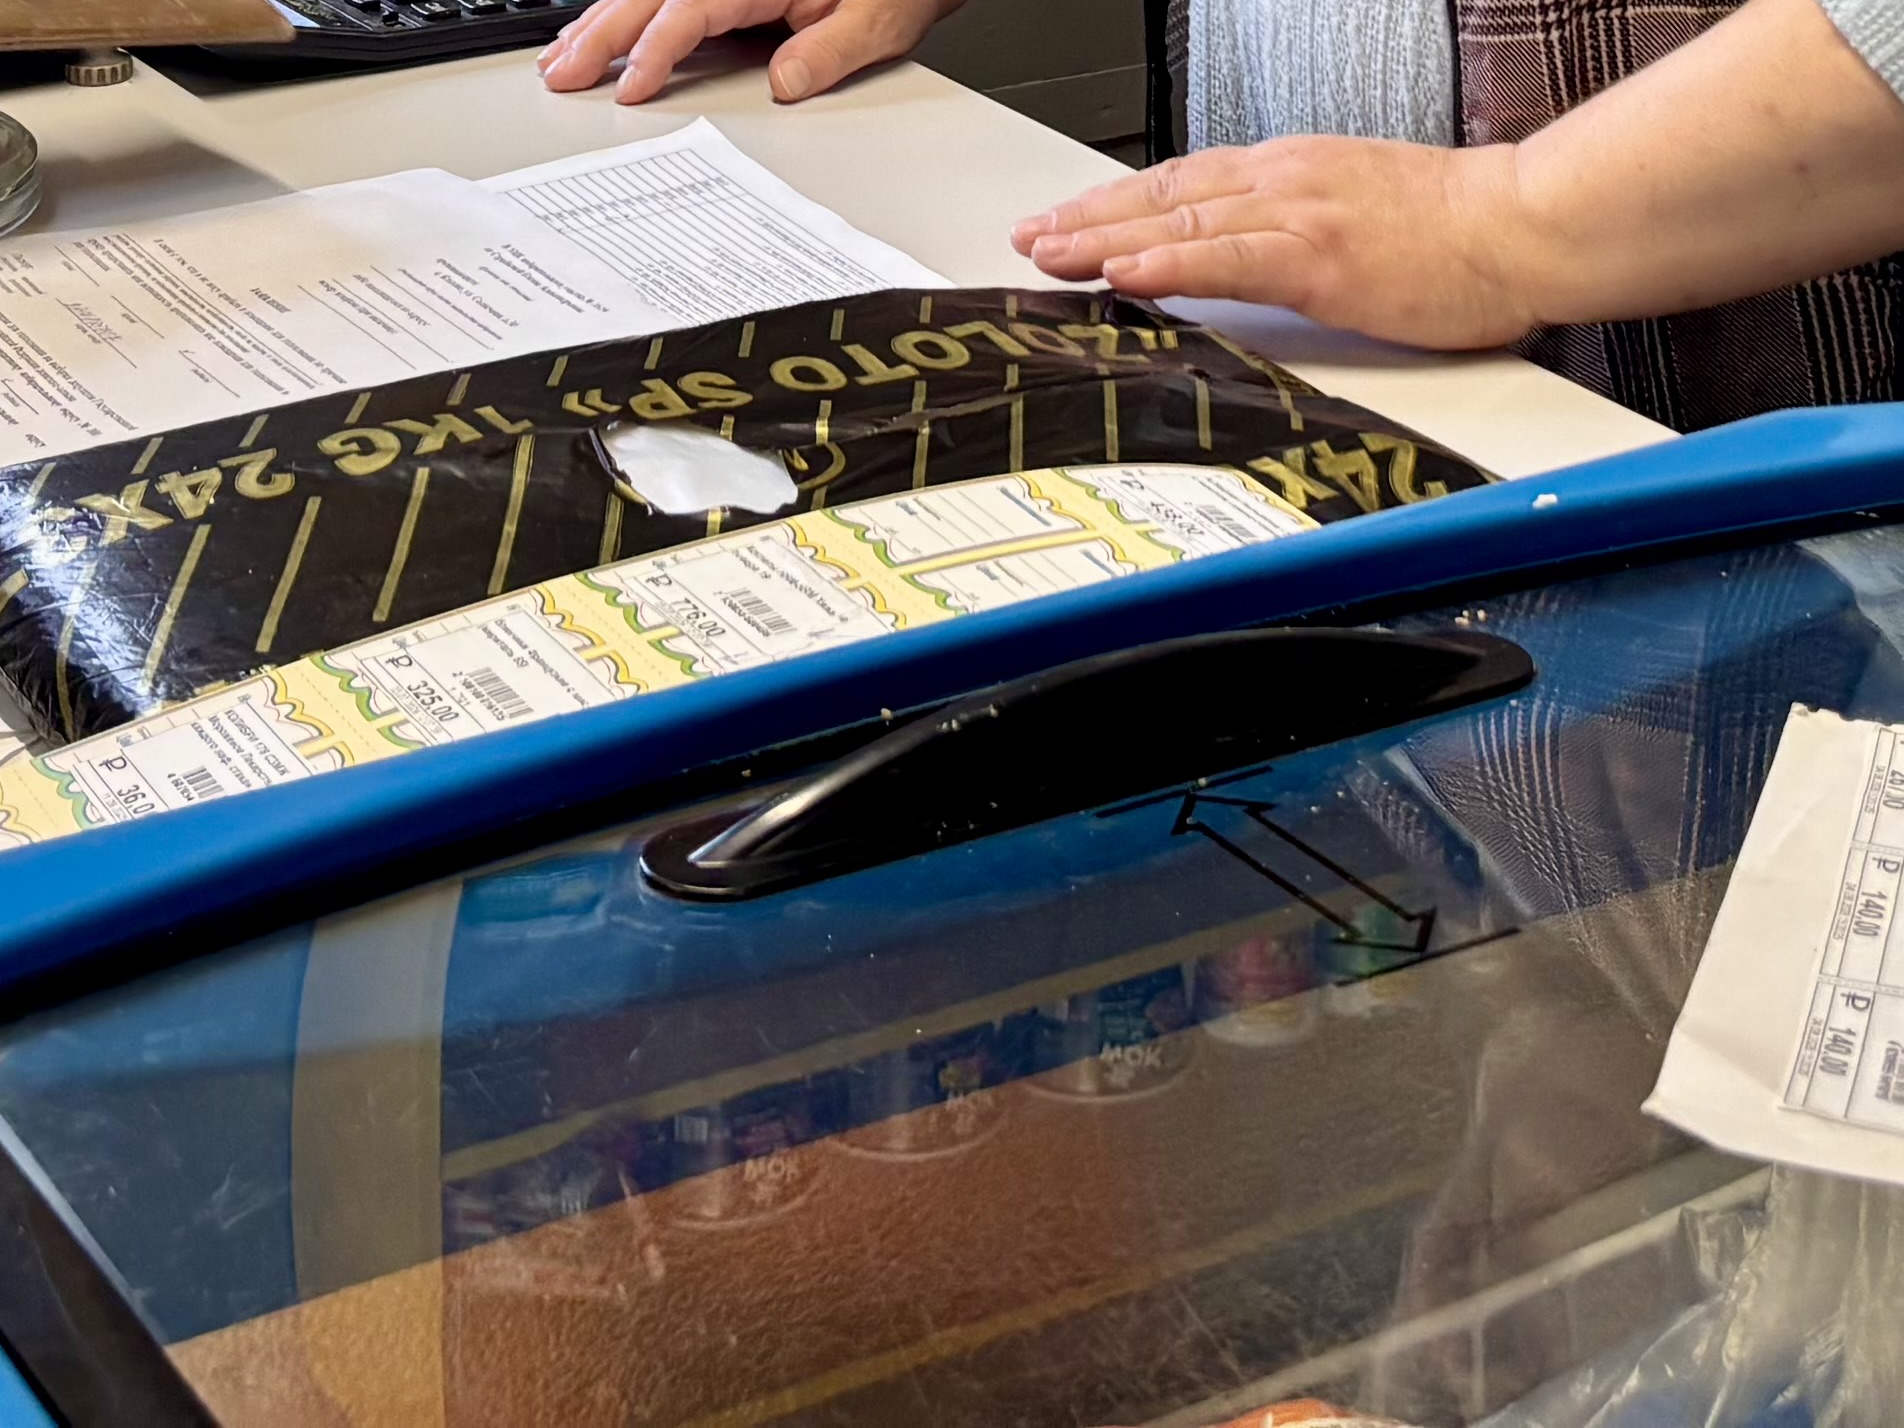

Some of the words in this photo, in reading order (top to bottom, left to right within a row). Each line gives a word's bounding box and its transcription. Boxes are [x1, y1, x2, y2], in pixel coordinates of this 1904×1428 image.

[405, 677, 461, 724] 325,00
[117, 781, 156, 815] 36,0
[1852, 890, 1888, 936] 140,00
[1819, 1026, 1857, 1076] 140,00
